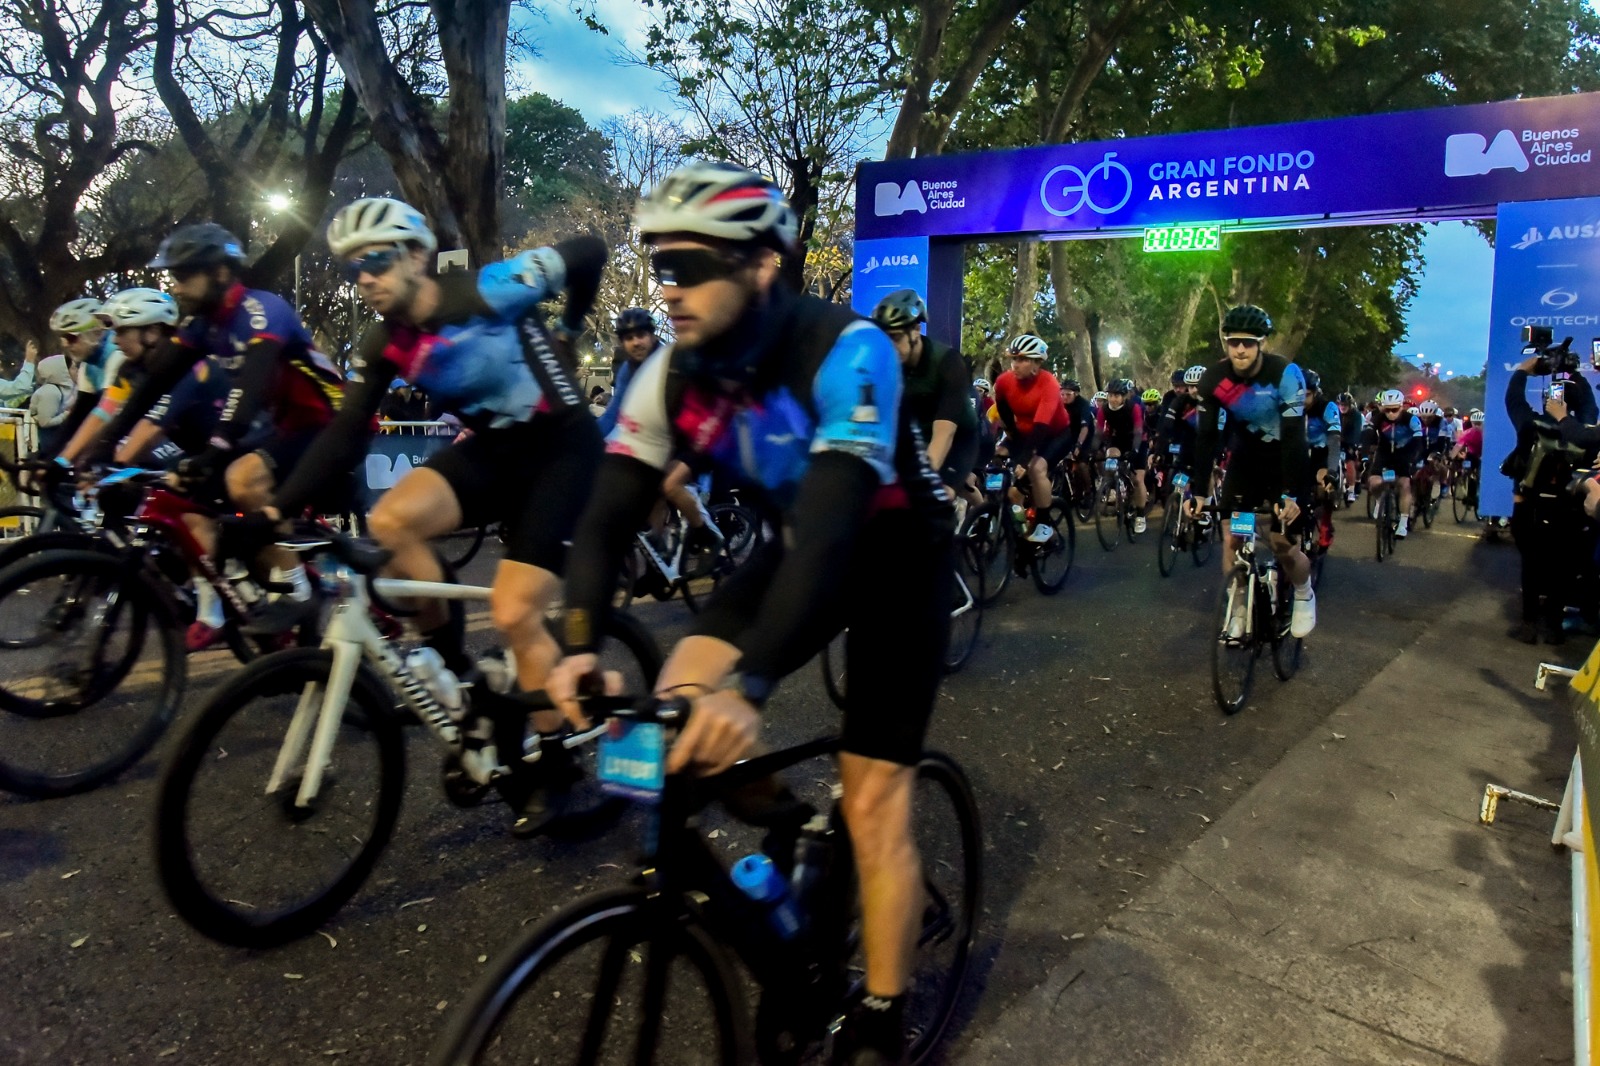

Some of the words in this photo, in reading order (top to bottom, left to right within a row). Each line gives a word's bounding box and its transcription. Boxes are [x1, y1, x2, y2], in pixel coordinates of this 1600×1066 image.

[1521, 128, 1580, 142] Buenos
[1530, 141, 1574, 155] Aires
[1534, 149, 1592, 166] Ciudad
[1148, 158, 1216, 182] GRAN
[1223, 150, 1315, 177] FONDO
[922, 180, 958, 191] Buenos
[1148, 173, 1311, 201] ARGENTINA
[927, 190, 955, 200] Aires
[930, 197, 965, 210] Ciudad
[881, 254, 919, 267] AUSA
[1510, 315, 1599, 327] OPTITECH
